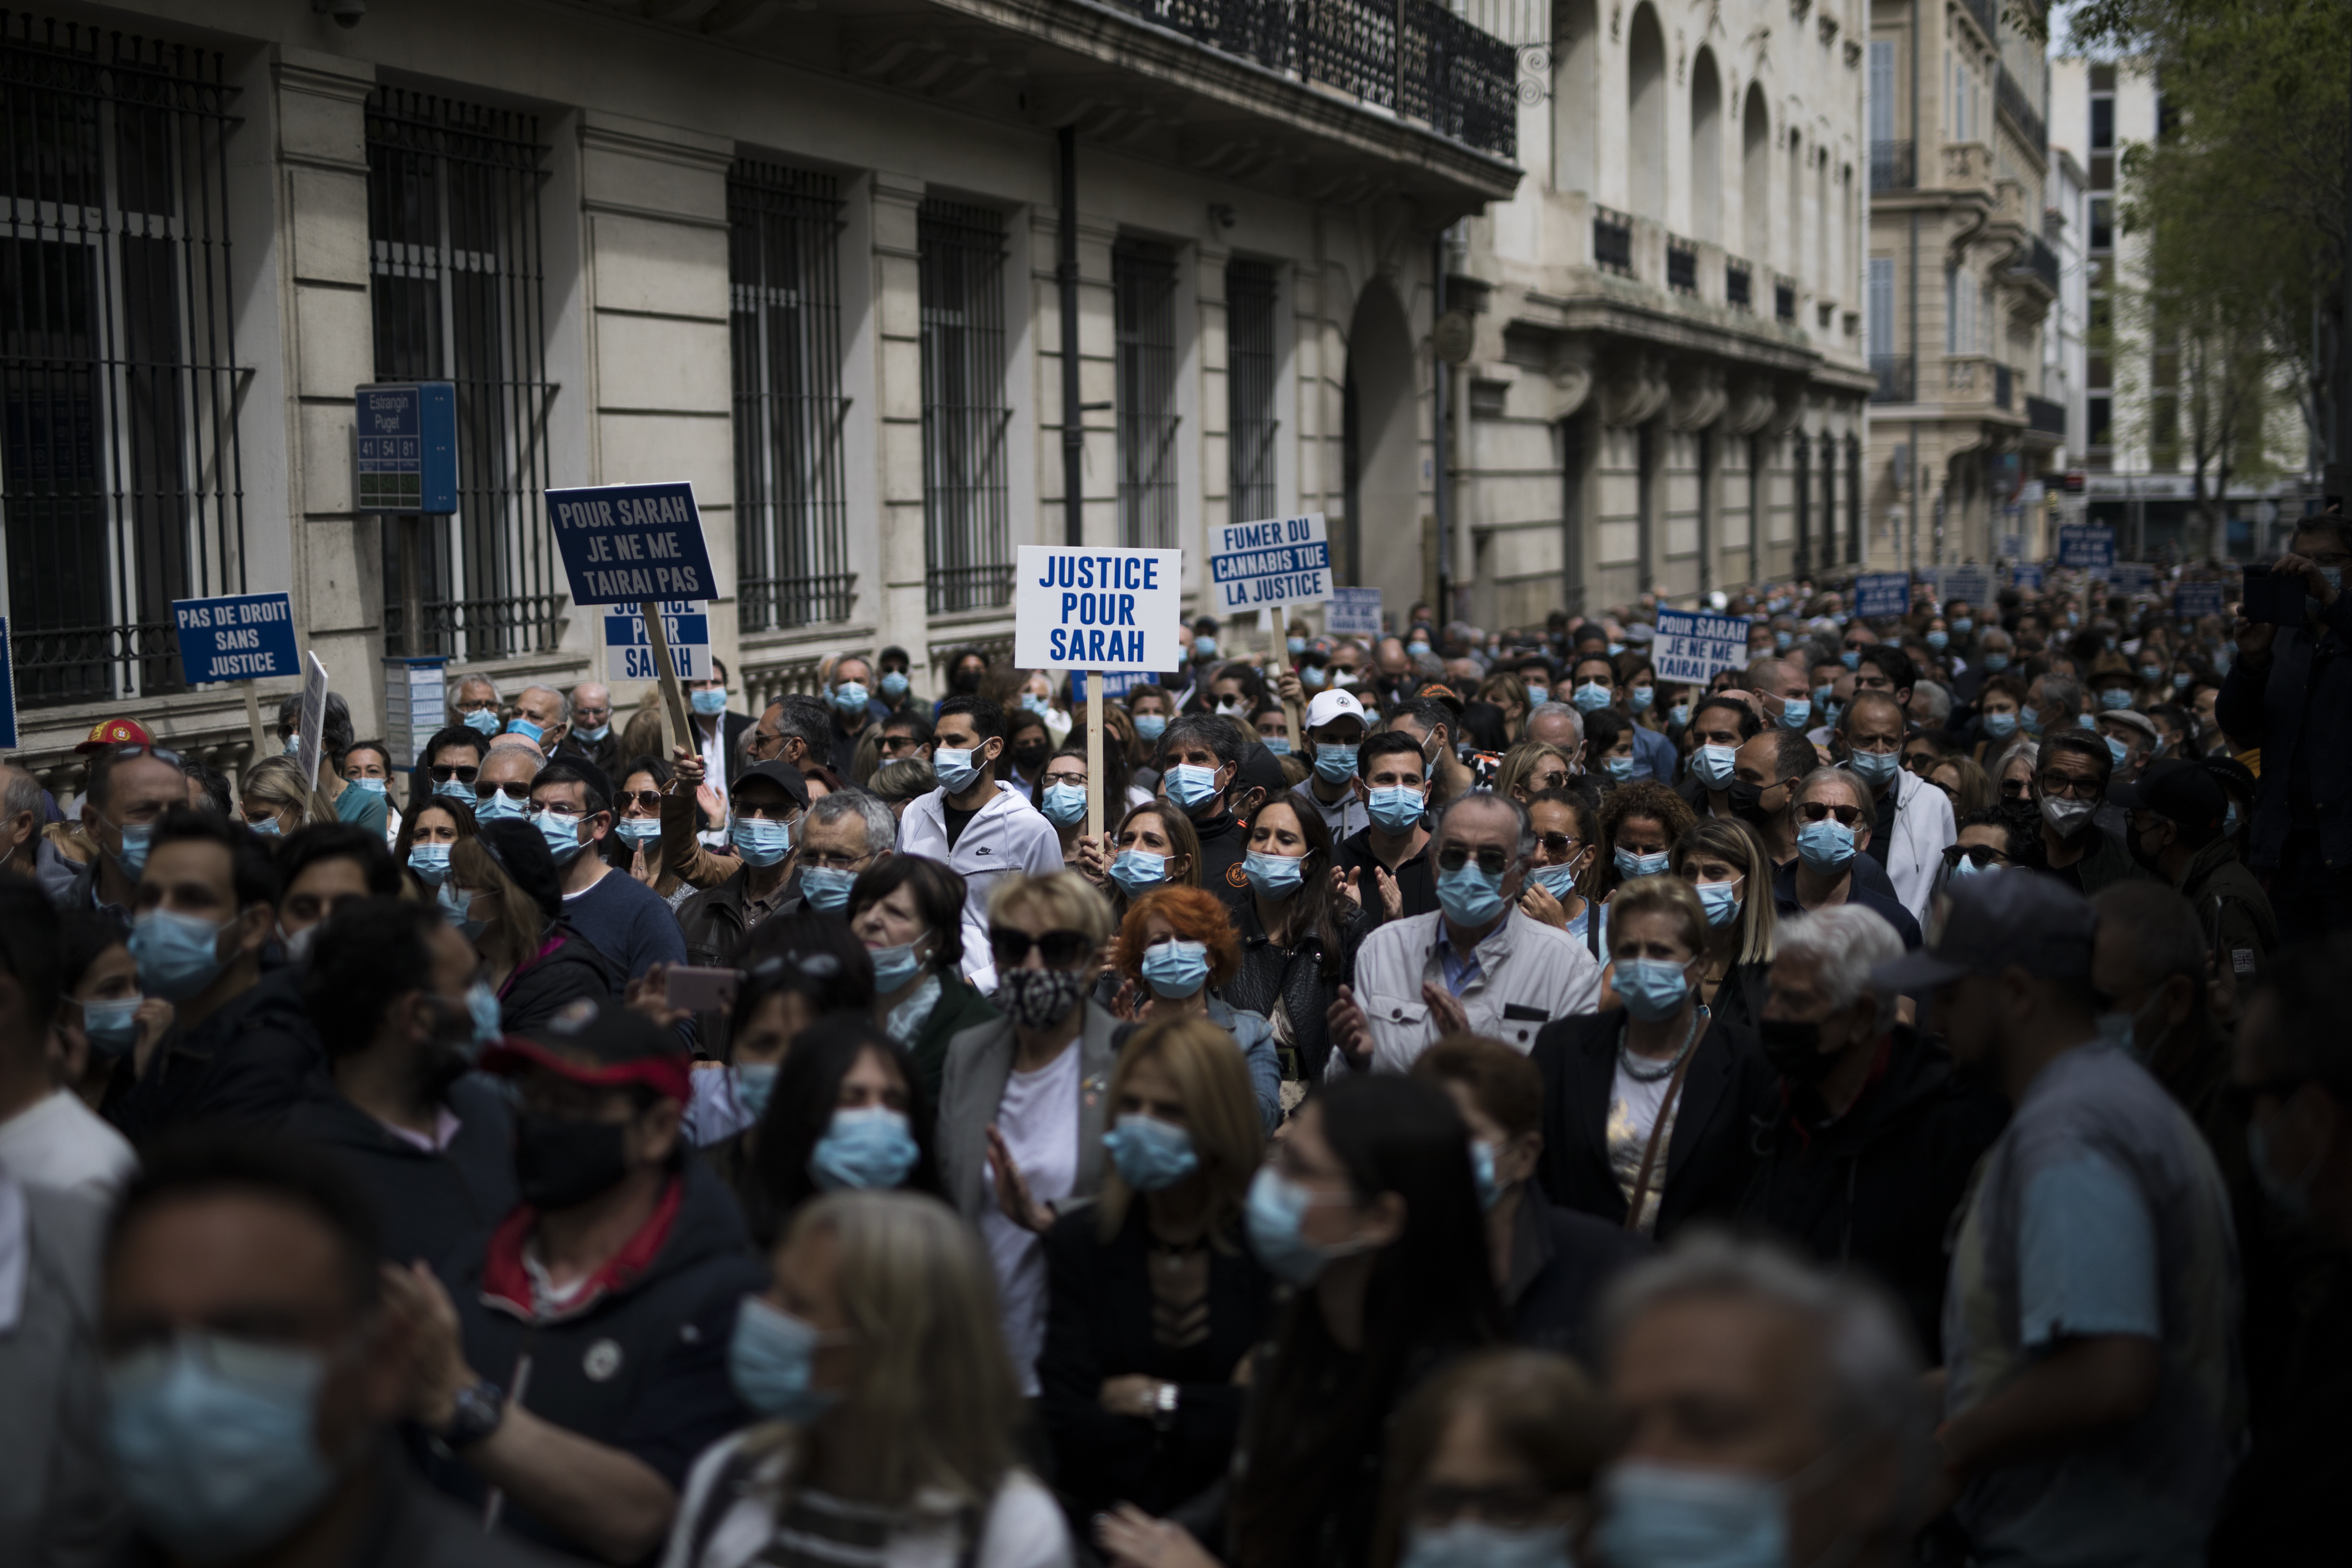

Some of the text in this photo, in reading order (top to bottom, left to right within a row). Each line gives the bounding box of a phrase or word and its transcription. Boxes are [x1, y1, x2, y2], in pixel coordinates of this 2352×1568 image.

[370, 393, 409, 413] Estrangin
[375, 414, 399, 433] Puget
[363, 440, 413, 456] 41 54 81
[362, 477, 418, 492] 521 540 518
[558, 496, 689, 529] POUR SARAH
[587, 533, 681, 561] JE NE ME
[1224, 519, 1309, 550] FUMER DU
[1039, 556, 1158, 589] JUSTICE
[1217, 546, 1325, 578] CANNABIS TUE
[583, 566, 699, 595] TAIRAI PAS
[1227, 572, 1322, 605] LA JUSTICE
[178, 601, 286, 628] PAS DE DROIT
[1062, 593, 1135, 625] POUR
[215, 629, 259, 651] SANS
[1658, 615, 1748, 641] POUR SARAH
[1050, 629, 1144, 662] SARAH
[1666, 638, 1733, 660] JE NE ME
[209, 652, 276, 676] JUSTICE
[1659, 657, 1705, 678] TAIRAI
